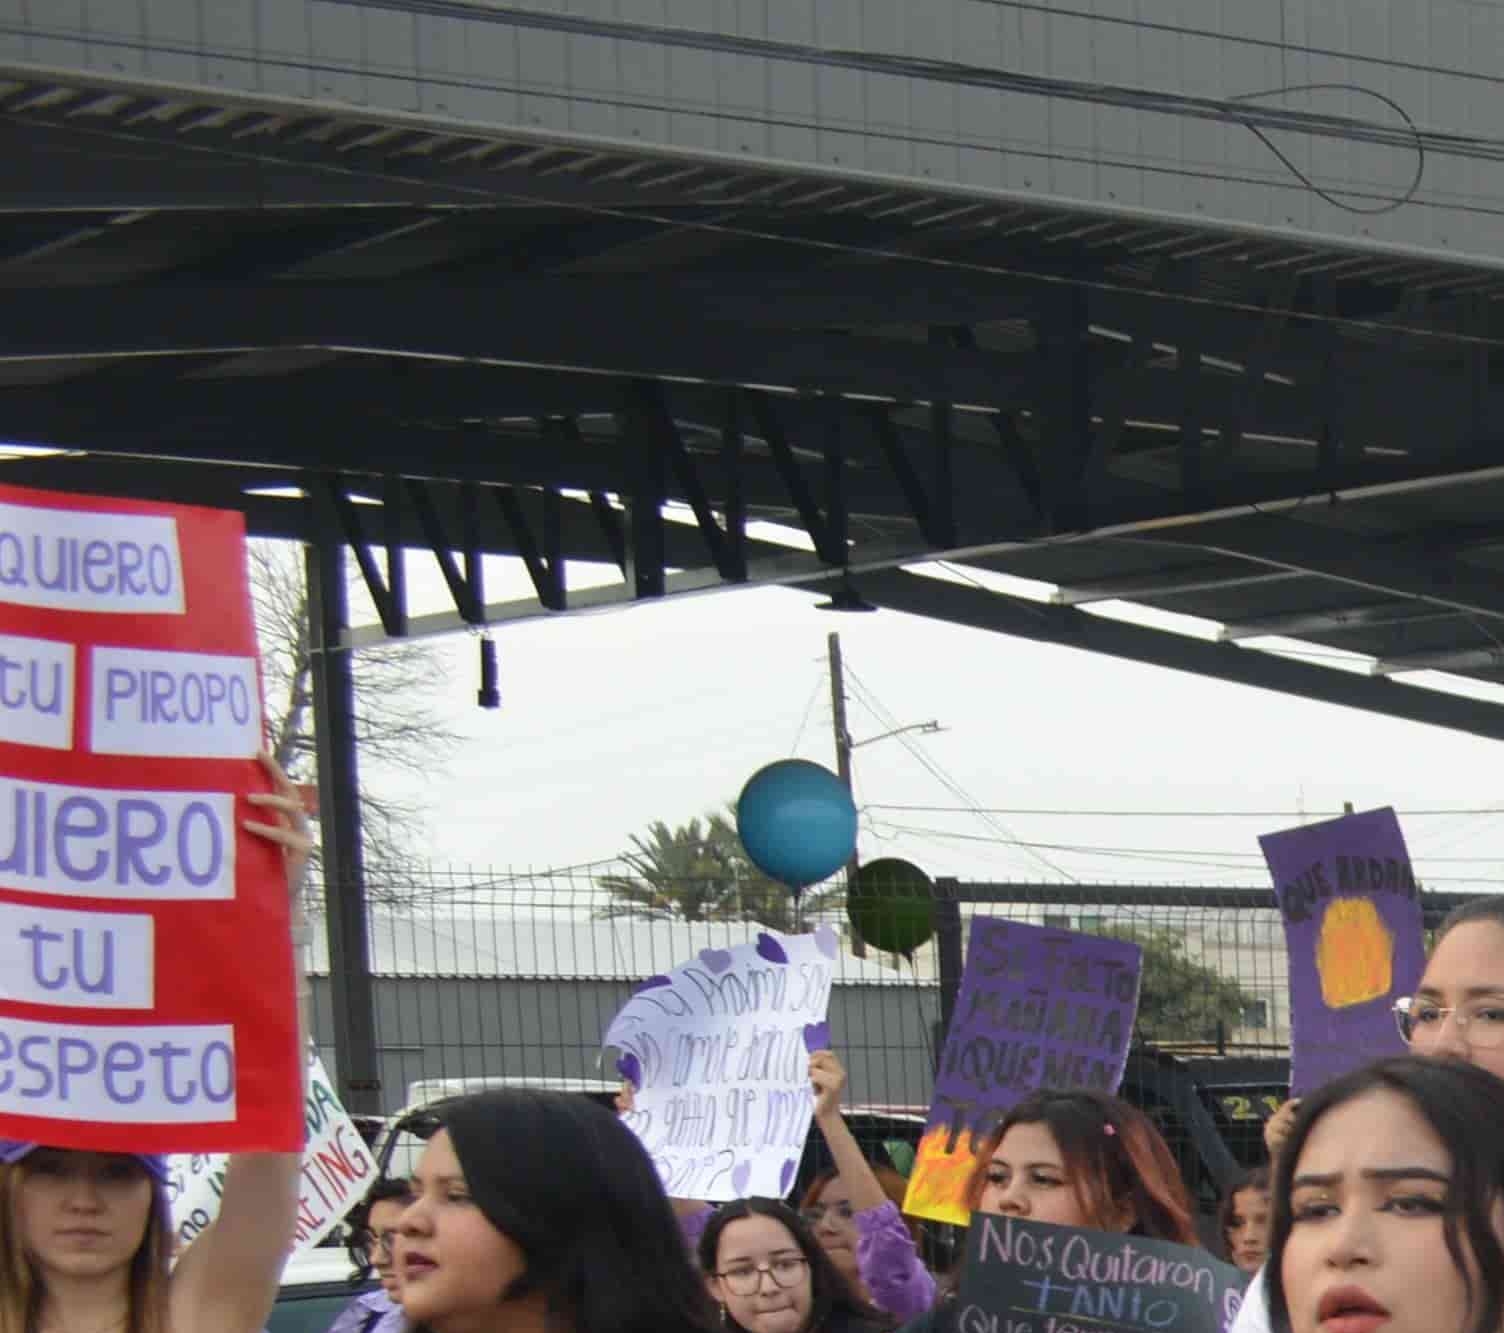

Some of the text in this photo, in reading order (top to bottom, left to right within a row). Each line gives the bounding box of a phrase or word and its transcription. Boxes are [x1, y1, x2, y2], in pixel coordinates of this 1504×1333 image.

[105, 668, 250, 726] PIROPO
[20, 924, 115, 995] tu
[979, 1217, 1215, 1305] Nos Quitaron
